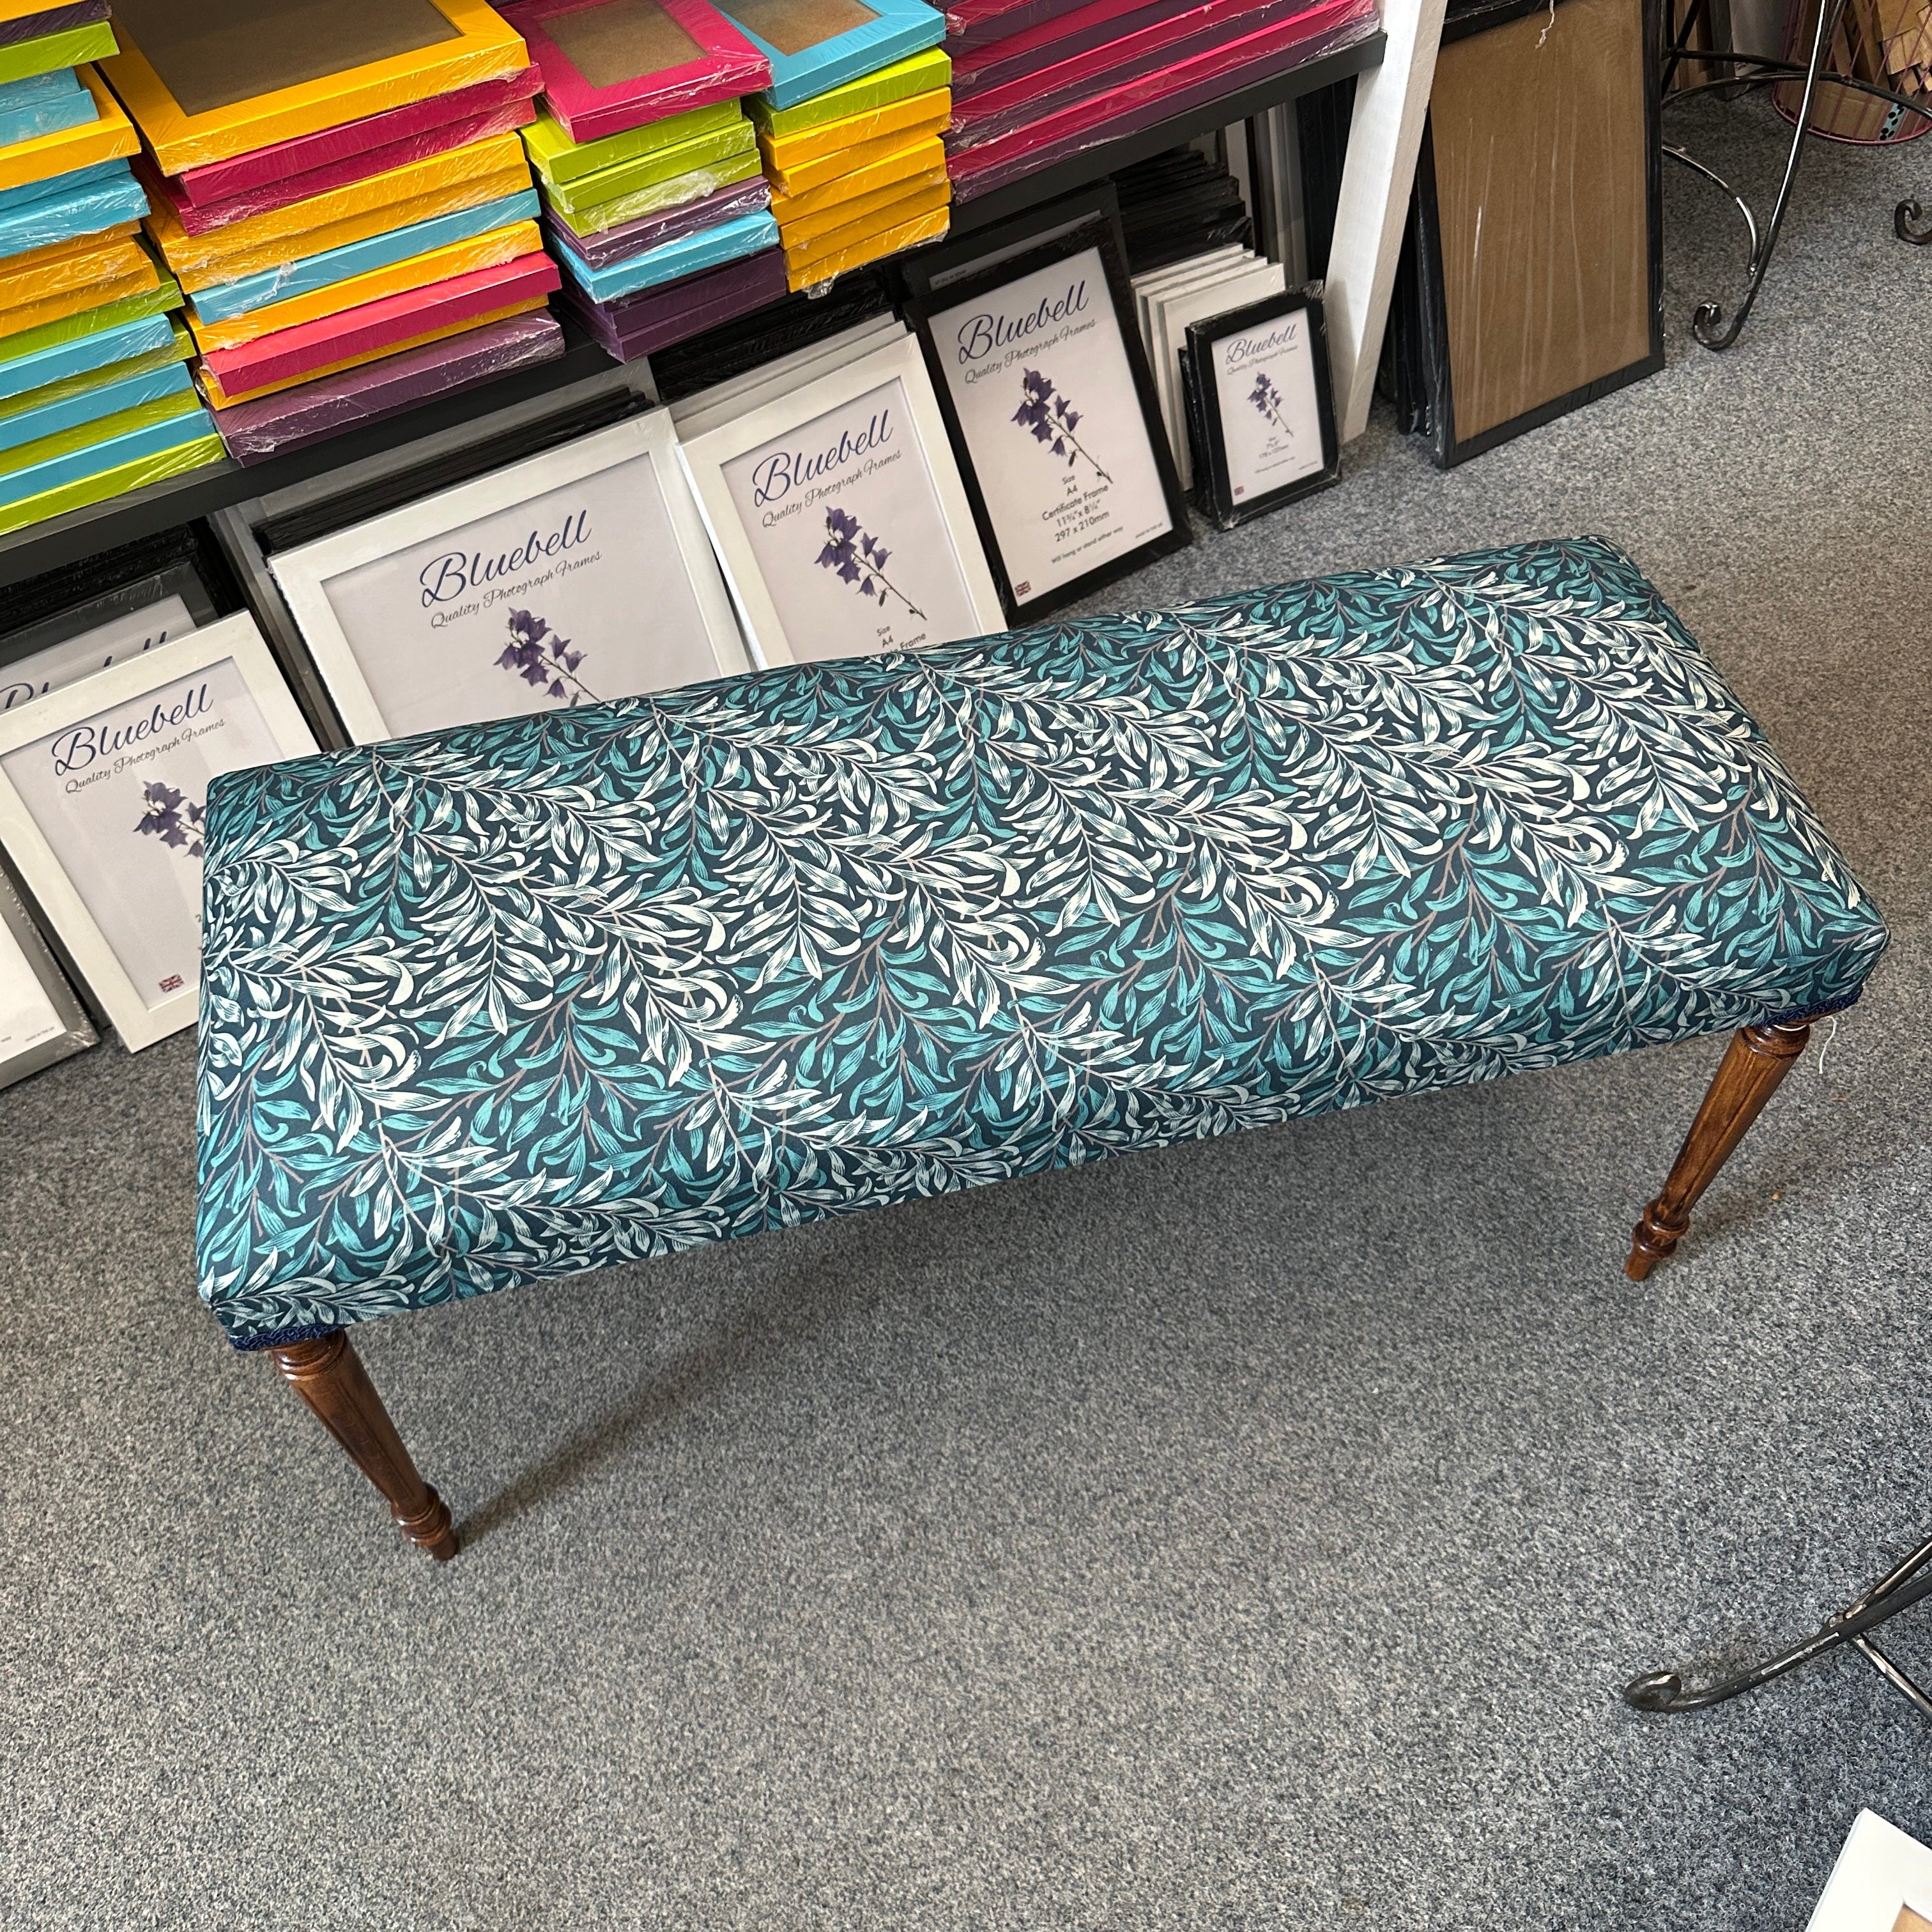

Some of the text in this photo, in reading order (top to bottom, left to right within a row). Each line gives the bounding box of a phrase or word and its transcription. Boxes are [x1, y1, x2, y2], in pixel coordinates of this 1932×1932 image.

[957, 280, 1089, 365] Bluebell
[1225, 324, 1297, 365] Bluebell
[965, 319, 1096, 385] Quality Photograph Frames
[752, 409, 894, 507] Bluebell
[1062, 475, 1075, 485] Size
[762, 449, 902, 528] Quality Photograph Frames
[1042, 485, 1108, 521] Certificate Frame
[1066, 484, 1078, 496] A4
[1055, 528, 1070, 542] 297
[1078, 511, 1110, 531] 210mm
[419, 510, 592, 608] Bluebell
[431, 551, 602, 629] Quality Photograph Frames
[877, 625, 891, 637] Size
[882, 634, 894, 648] A4
[900, 633, 926, 650] Frame
[51, 684, 214, 776] Bluebell
[65, 718, 226, 794] Quality Photograph Frames
